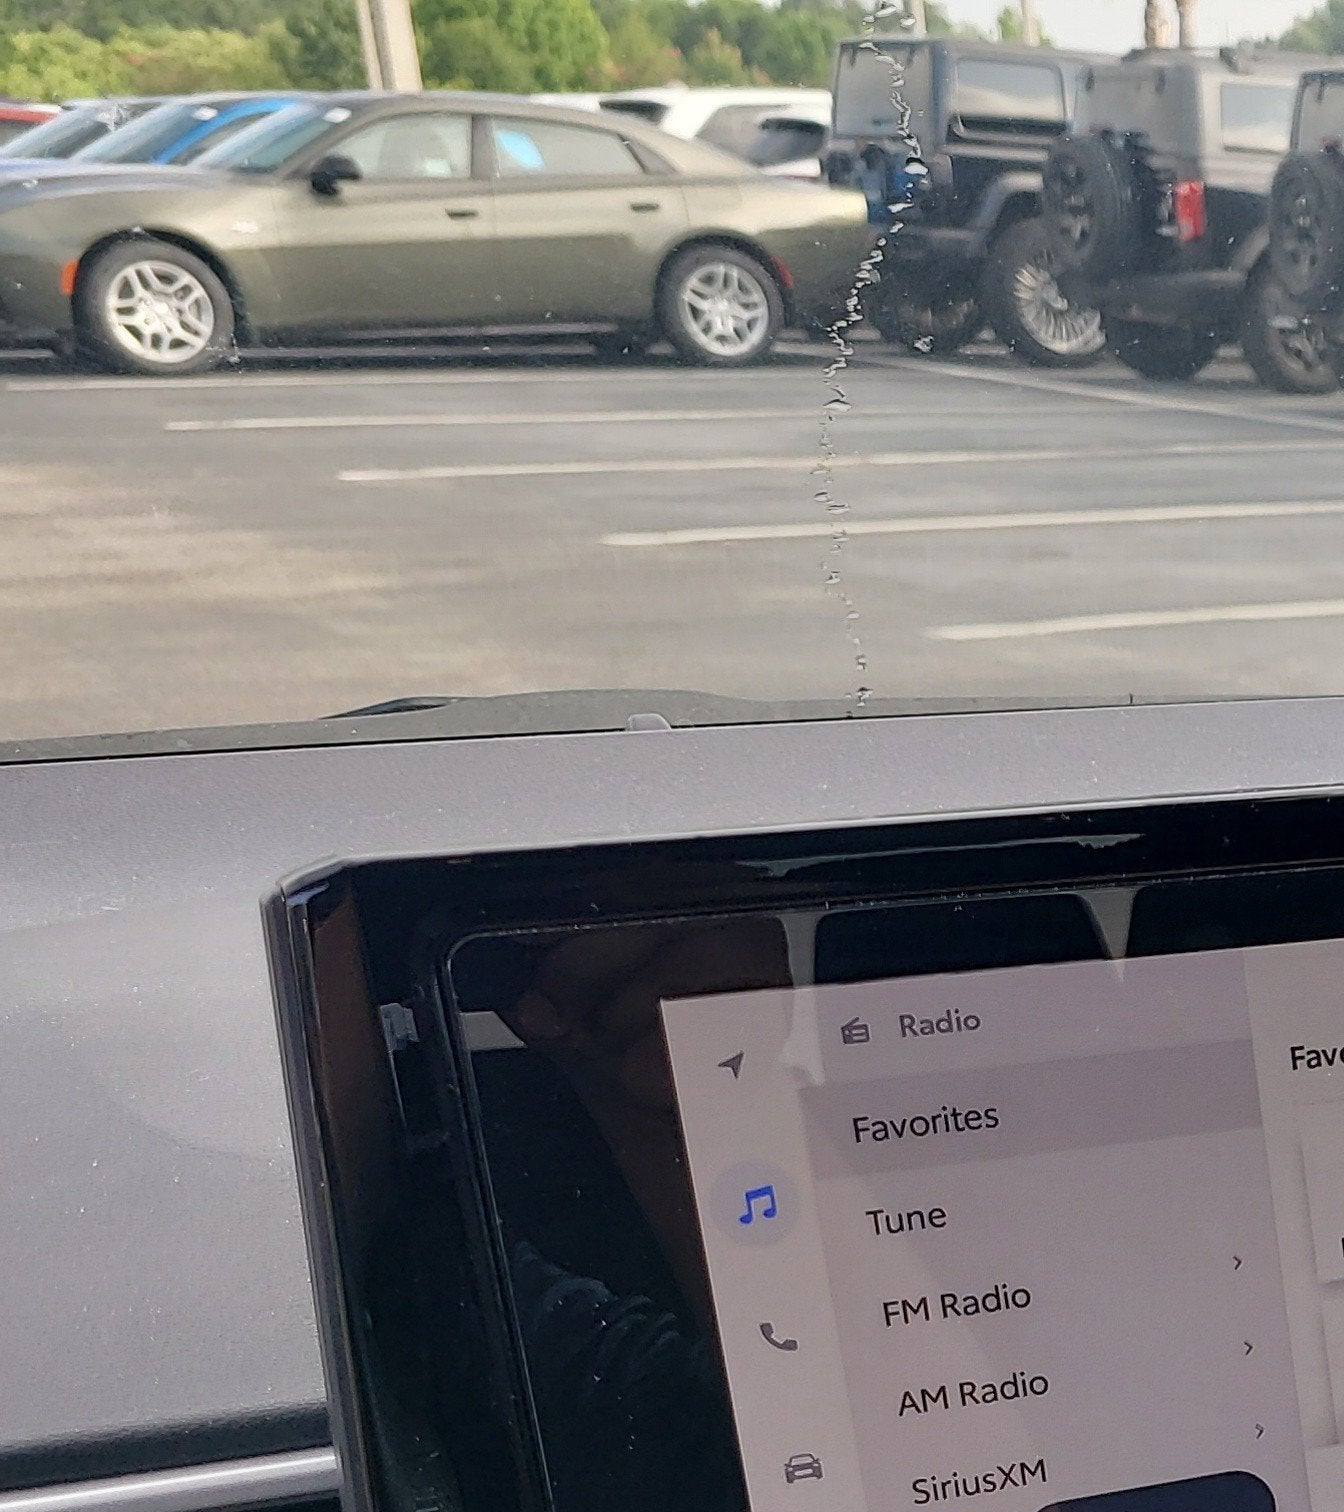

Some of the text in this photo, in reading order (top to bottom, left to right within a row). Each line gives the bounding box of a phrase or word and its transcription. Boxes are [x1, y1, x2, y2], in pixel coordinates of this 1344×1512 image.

[898, 1008, 982, 1039] Radio
[852, 1104, 1000, 1143] Favorites
[866, 1205, 948, 1237] Tune
[882, 1283, 1032, 1328] FM Radio
[898, 1370, 1050, 1417] AM Radio
[912, 1458, 1048, 1505] SiriusXM
